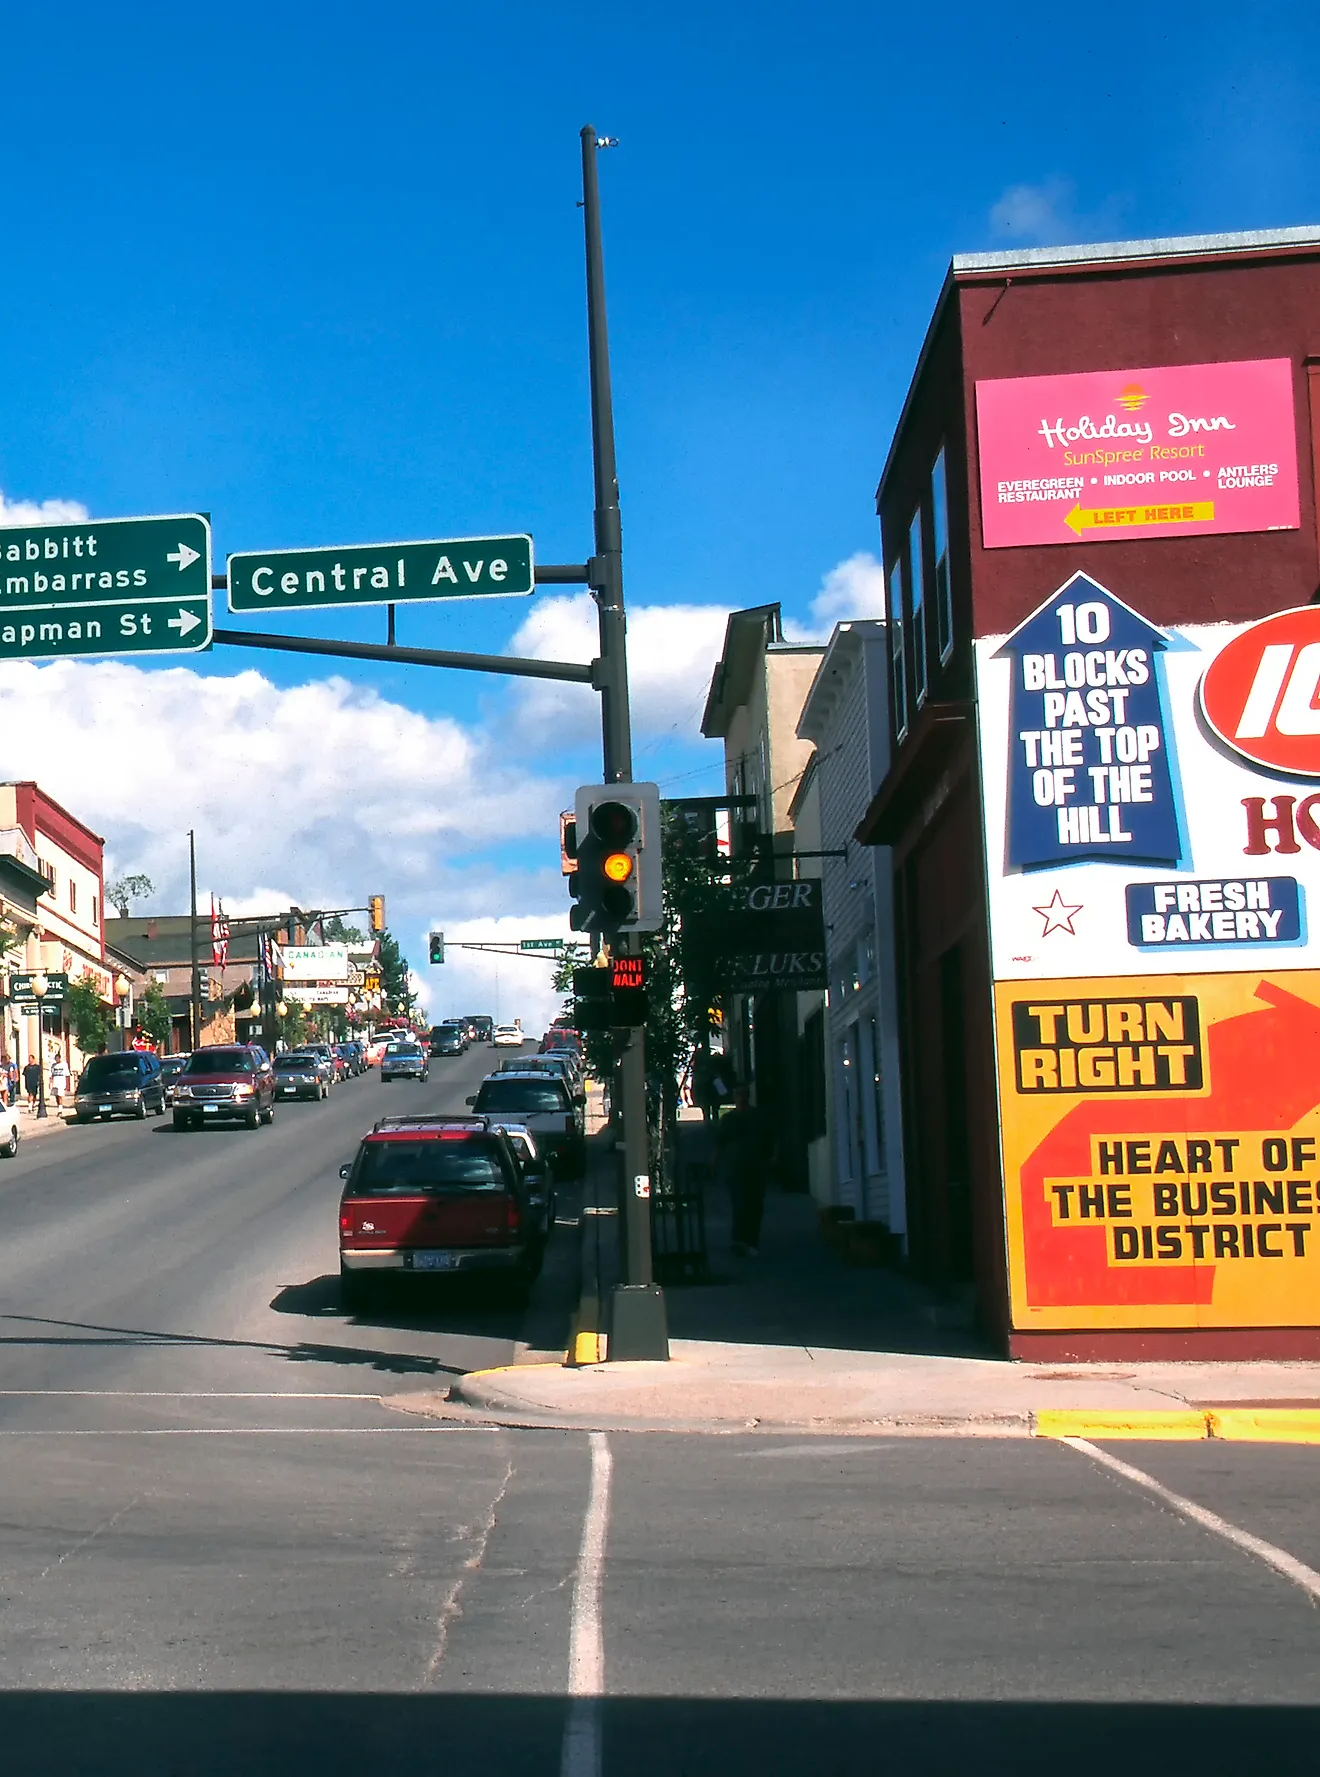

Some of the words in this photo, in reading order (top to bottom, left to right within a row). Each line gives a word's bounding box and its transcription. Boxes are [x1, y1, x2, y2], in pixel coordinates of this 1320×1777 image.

[1038, 415, 1153, 449] Holiday
[1168, 412, 1236, 438] Inn
[1063, 448, 1143, 467] SunSpree
[1149, 443, 1205, 460] Resort
[1217, 464, 1279, 478] ANTLERS
[997, 476, 1084, 492] EVEREGREEN
[1103, 472, 1155, 486] INDOOR
[1159, 469, 1197, 483] POOL
[1217, 475, 1274, 489] LOUNGE
[997, 488, 1082, 503] RESTAURANT
[1093, 510, 1136, 525] LEFT
[1145, 506, 1195, 521] HERE
[250, 558, 407, 598] Central
[430, 555, 510, 588] Ave
[119, 612, 154, 638] St
[1055, 601, 1111, 646] 10
[1021, 648, 1150, 692] BLOCKS
[1043, 688, 1131, 729] PAST
[1019, 729, 1084, 768] THE
[1094, 724, 1160, 764] TOP
[1032, 768, 1077, 807] OF
[1088, 764, 1153, 804] THE
[1057, 804, 1133, 845] HILL
[1153, 880, 1271, 914] FRESH
[1140, 909, 1283, 943] BAKERY
[288, 950, 344, 960] CANADIAN
[538, 940, 552, 948] Ave
[1028, 1001, 1185, 1045] TURN
[1020, 1044, 1195, 1089] RIGHT
[1098, 1138, 1241, 1175] HEART
[1262, 1136, 1317, 1172] OF
[1051, 1184, 1133, 1219] THE
[1113, 1223, 1312, 1260] DISTRICT
